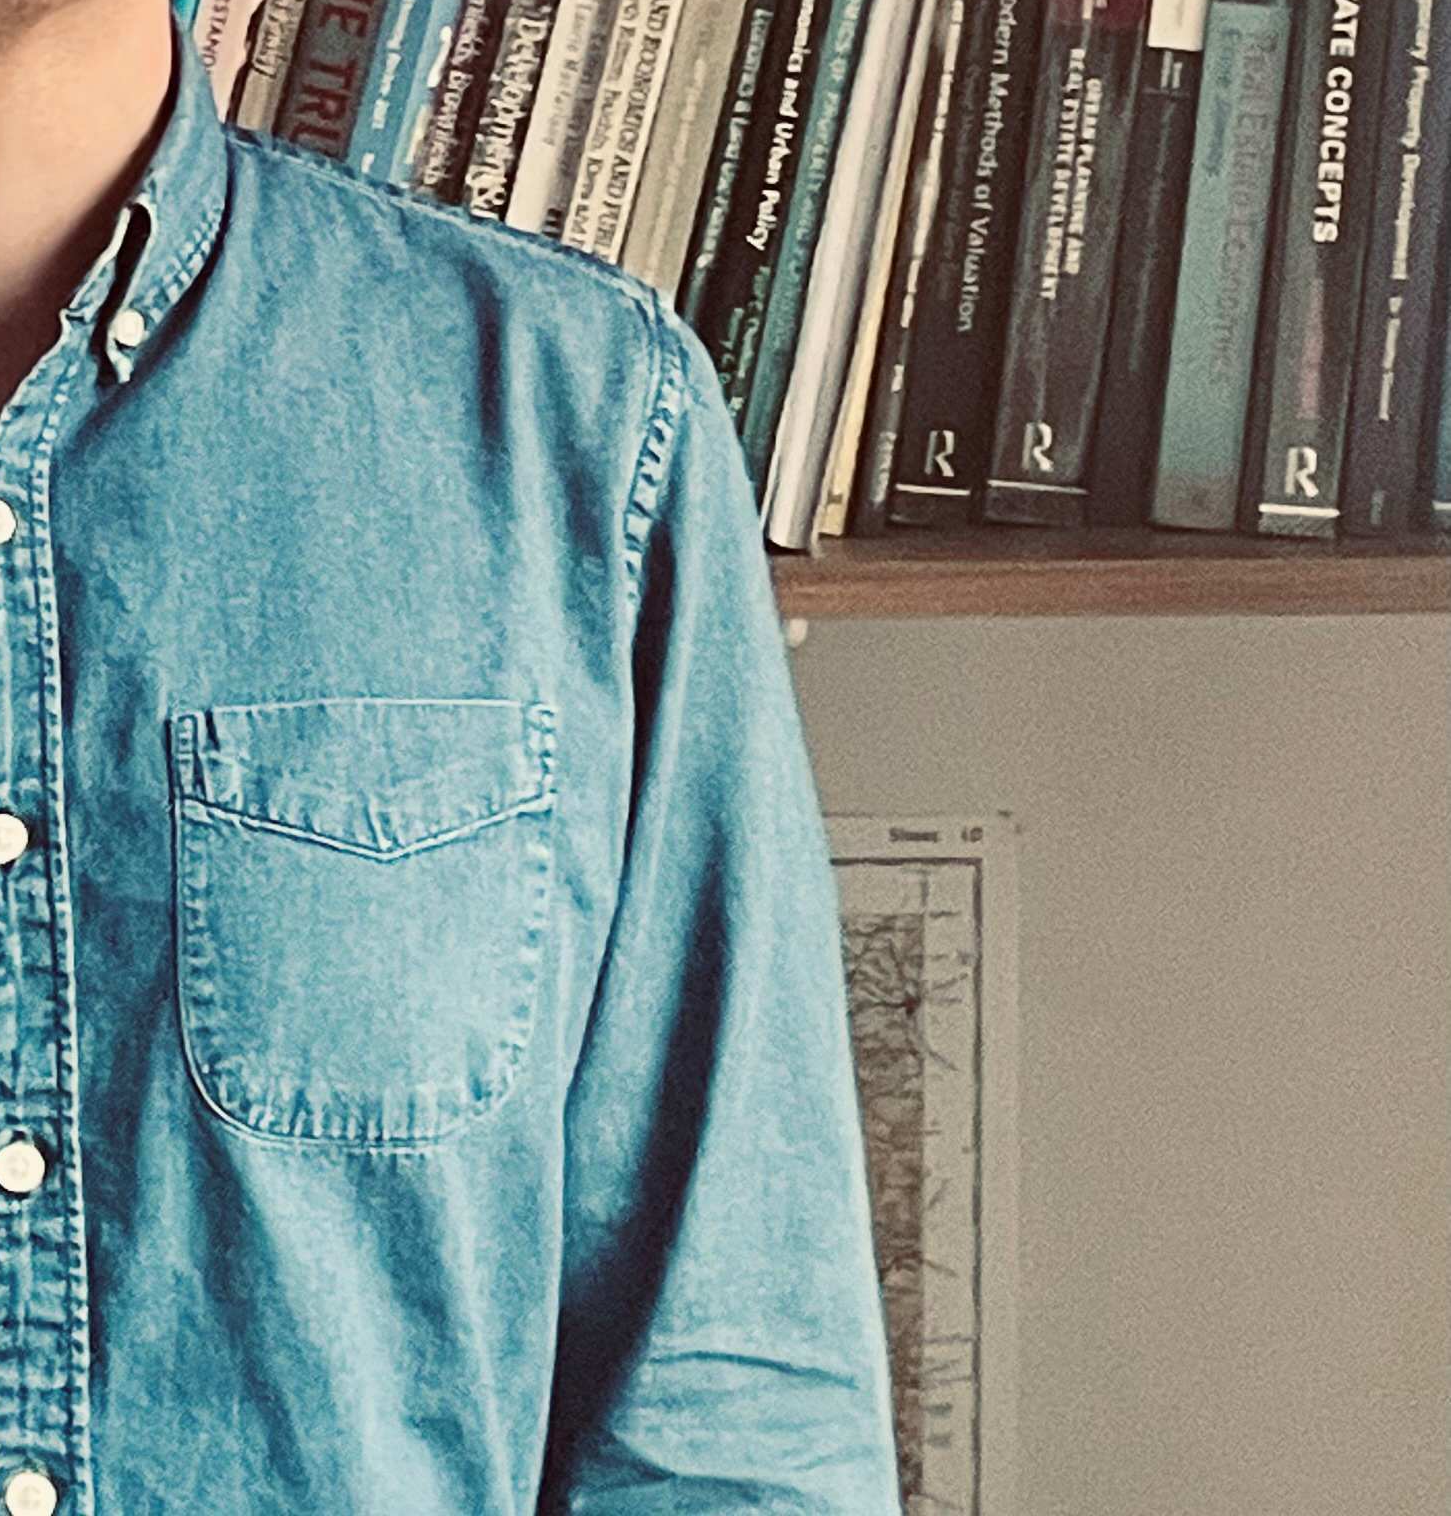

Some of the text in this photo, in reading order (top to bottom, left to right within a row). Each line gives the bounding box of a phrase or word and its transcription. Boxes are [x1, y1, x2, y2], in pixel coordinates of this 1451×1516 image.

[617, 34, 660, 154] ECONOMICS
[779, 77, 799, 118] and
[976, 72, 1010, 177] Methods
[607, 154, 631, 199] AND
[765, 122, 794, 185] Urban
[973, 184, 993, 210] of
[1040, 48, 1086, 300] REAL ESTATE DEVELOPMENT
[1068, 143, 1095, 235] PLANNING
[1312, 66, 1353, 243] CONCEPTS
[745, 189, 781, 251] Policy
[957, 216, 990, 332] Valuation
